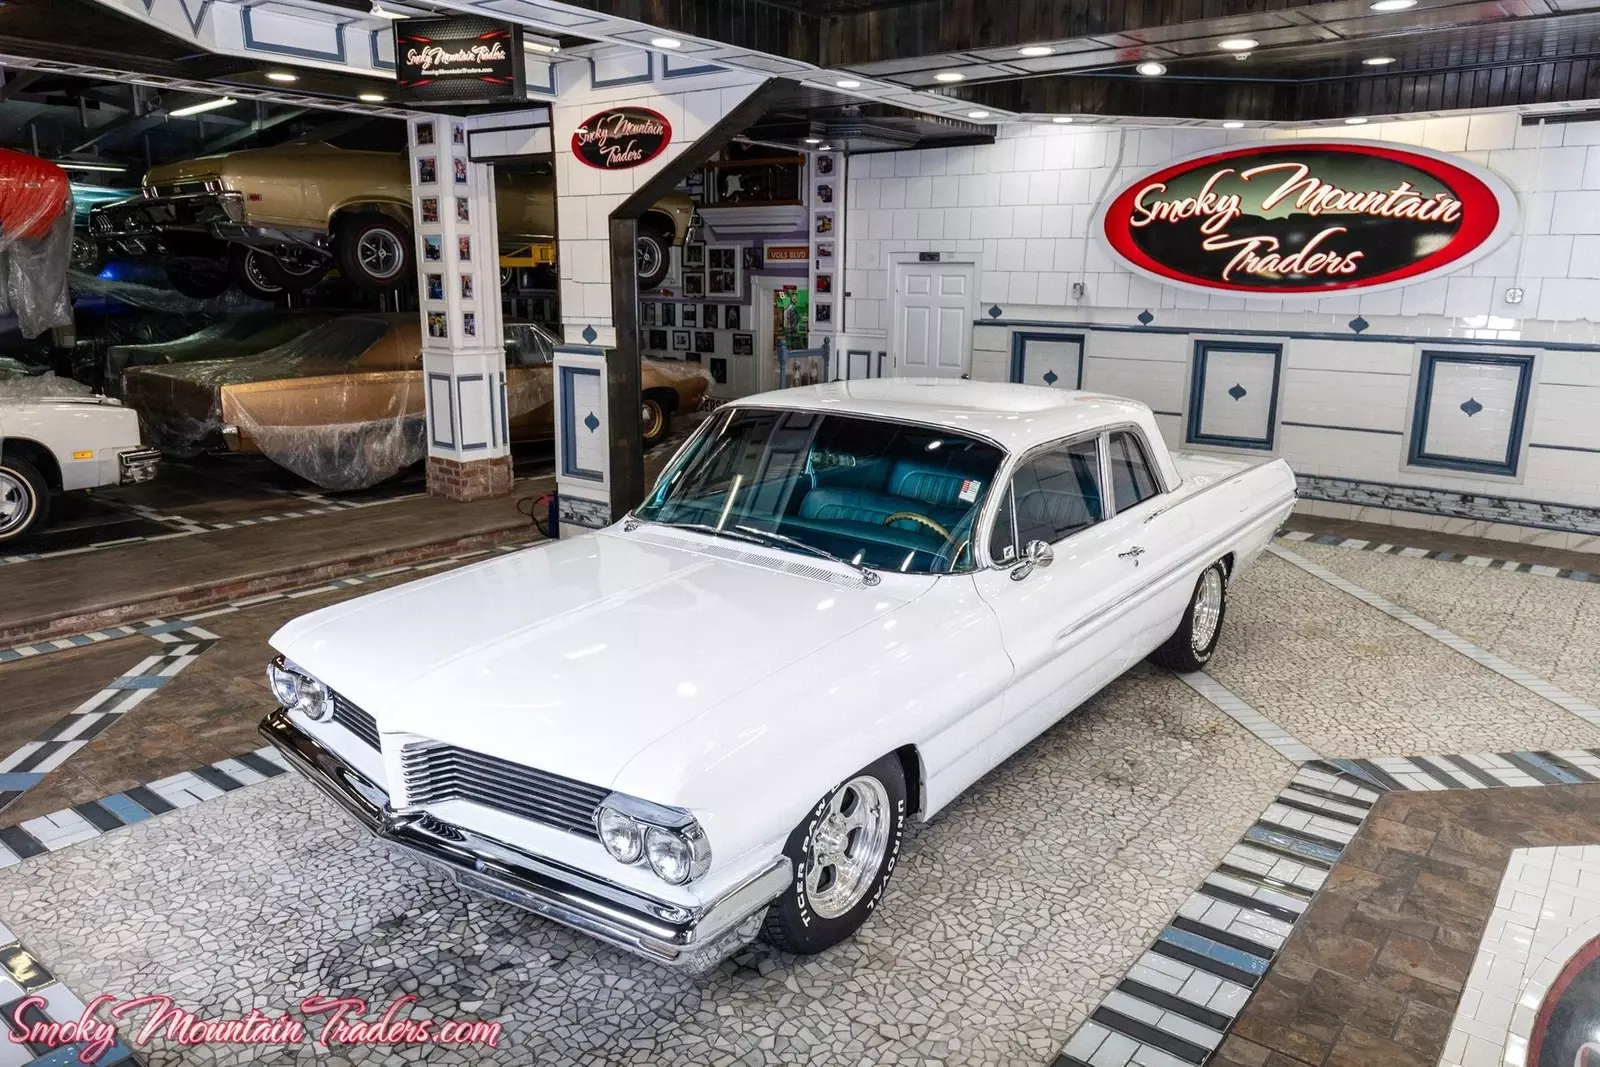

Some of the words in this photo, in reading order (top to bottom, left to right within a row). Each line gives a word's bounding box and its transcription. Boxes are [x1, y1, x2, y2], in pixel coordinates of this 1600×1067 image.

[406, 45, 432, 69] Smoky
[428, 46, 476, 65] Mountain
[471, 41, 506, 63] Traders
[577, 117, 608, 147] Smoky
[607, 113, 664, 136] Mountain
[599, 139, 642, 167] Traders
[1129, 168, 1242, 234] Smoky
[1240, 162, 1464, 224] Mountain
[771, 251, 788, 259] VOLS
[788, 250, 807, 259] BLVD
[1202, 227, 1365, 281] Traders
[802, 798, 826, 853] PAW
[866, 799, 904, 909] UNIROYAL
[796, 862, 811, 928] TIGER
